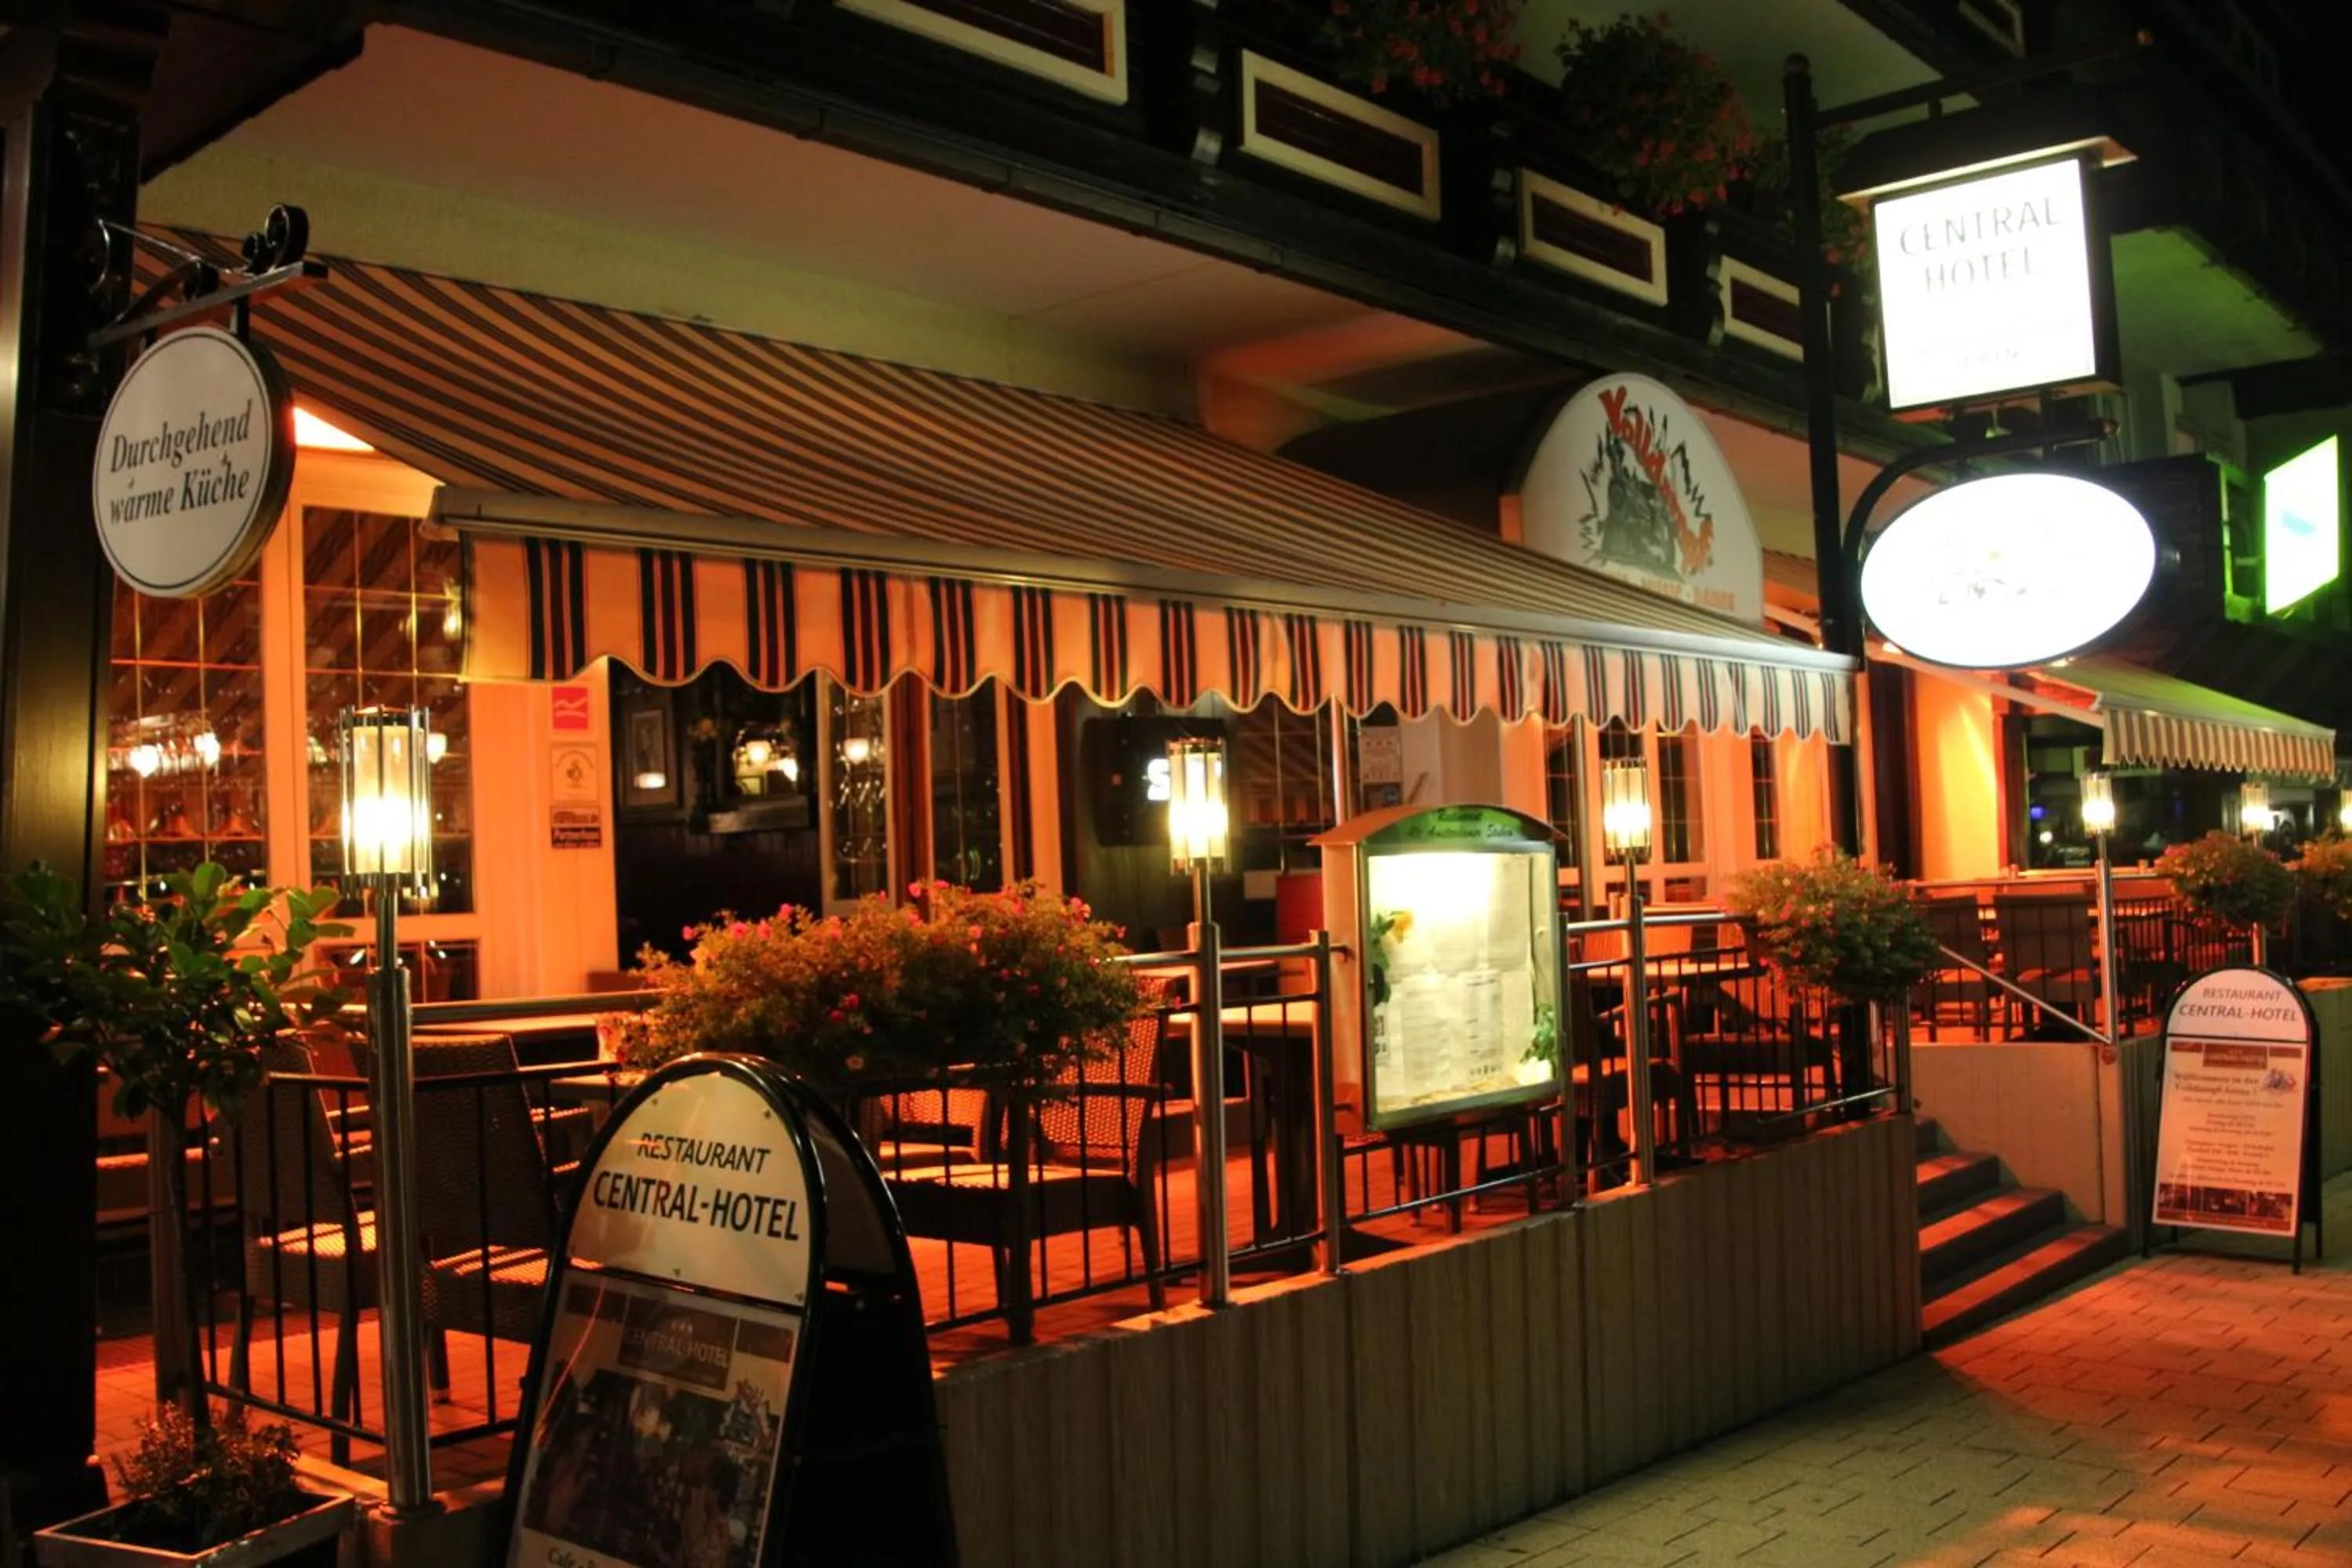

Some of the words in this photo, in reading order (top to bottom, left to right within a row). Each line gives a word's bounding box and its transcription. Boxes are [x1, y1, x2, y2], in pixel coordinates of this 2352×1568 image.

[1899, 196, 2063, 256] CENTRAL
[1925, 246, 2035, 294] HOTEL
[111, 398, 252, 474] Durchgehend
[180, 461, 251, 511] Küche
[2178, 1004, 2297, 1022] CENTRAL-HOTEL
[2202, 987, 2281, 1002] RESTAURANT
[637, 1132, 771, 1174] RESTAURANT
[593, 1171, 800, 1242] CENTRAL-HOTEL
[627, 1327, 682, 1357] CENTRAL
[688, 1341, 729, 1369] HOTEL
